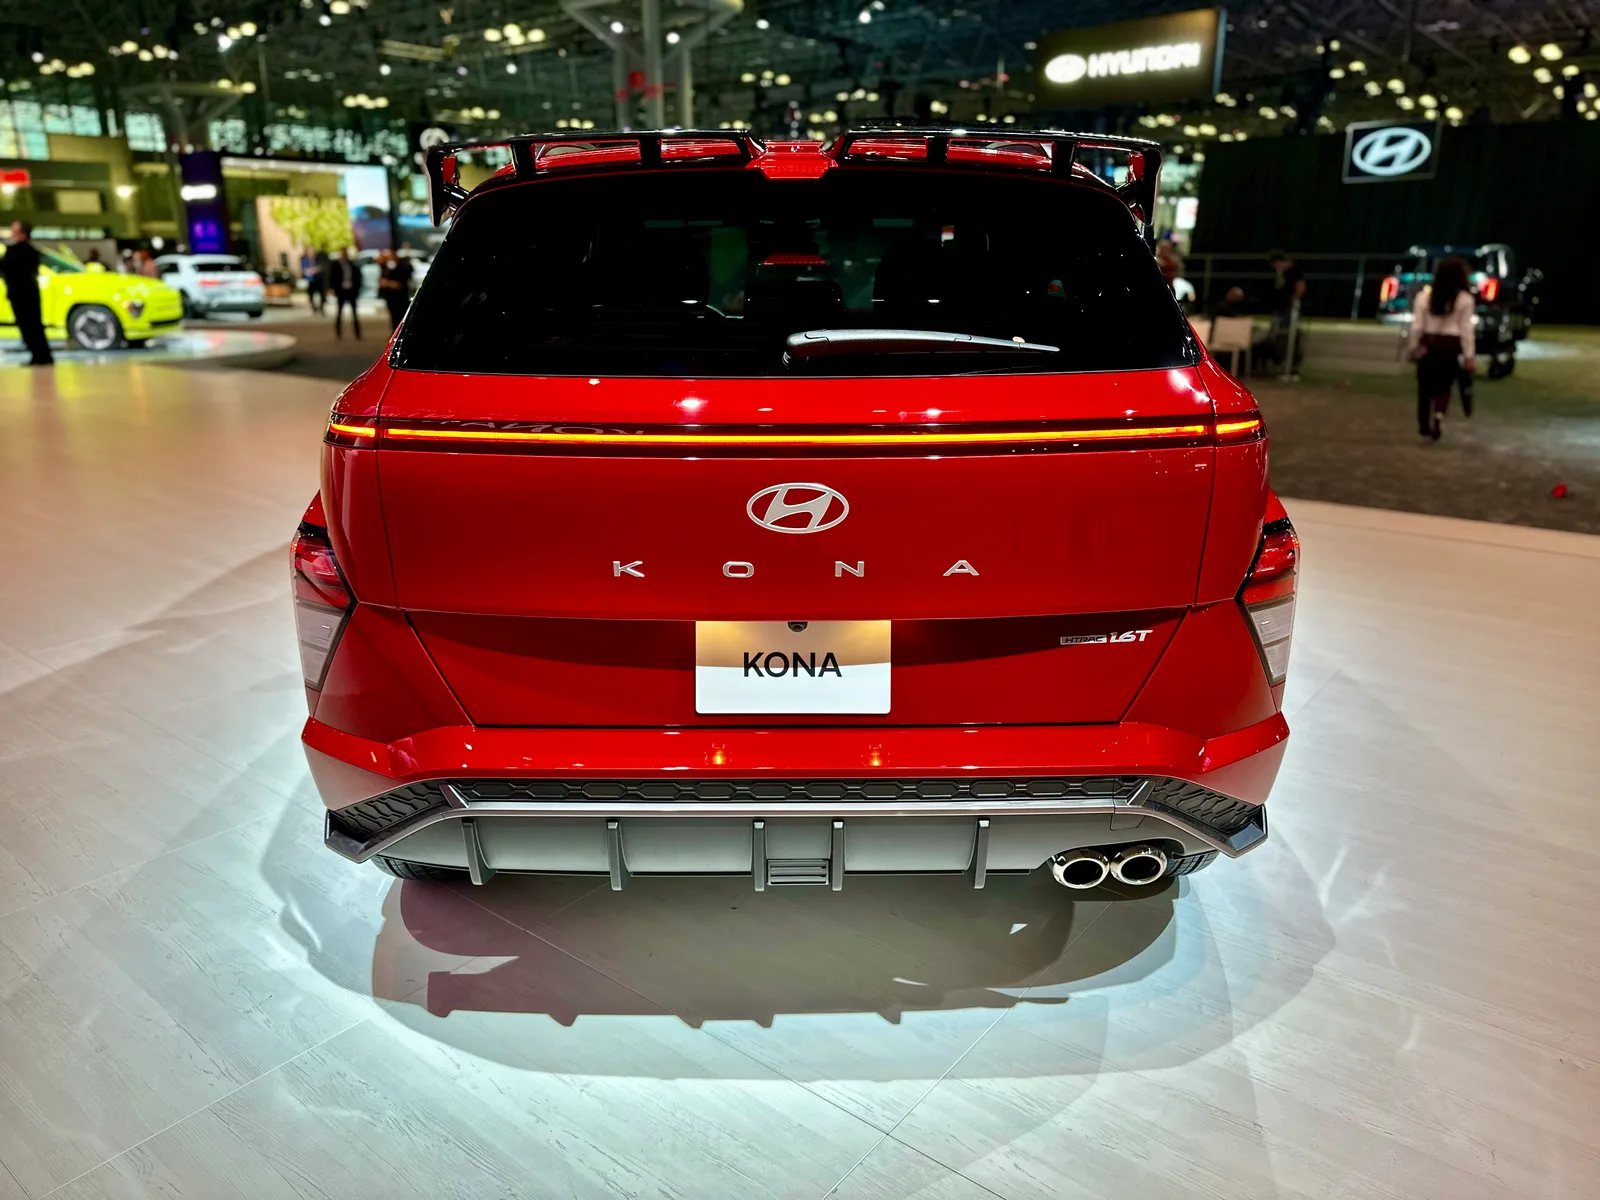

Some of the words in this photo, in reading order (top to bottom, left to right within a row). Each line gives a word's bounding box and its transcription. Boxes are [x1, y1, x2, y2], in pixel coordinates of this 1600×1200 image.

[1087, 42, 1201, 78] HYUNDAI
[612, 560, 980, 578] KONA
[1061, 635, 1106, 644] HTRAC
[743, 652, 843, 678] KONA
